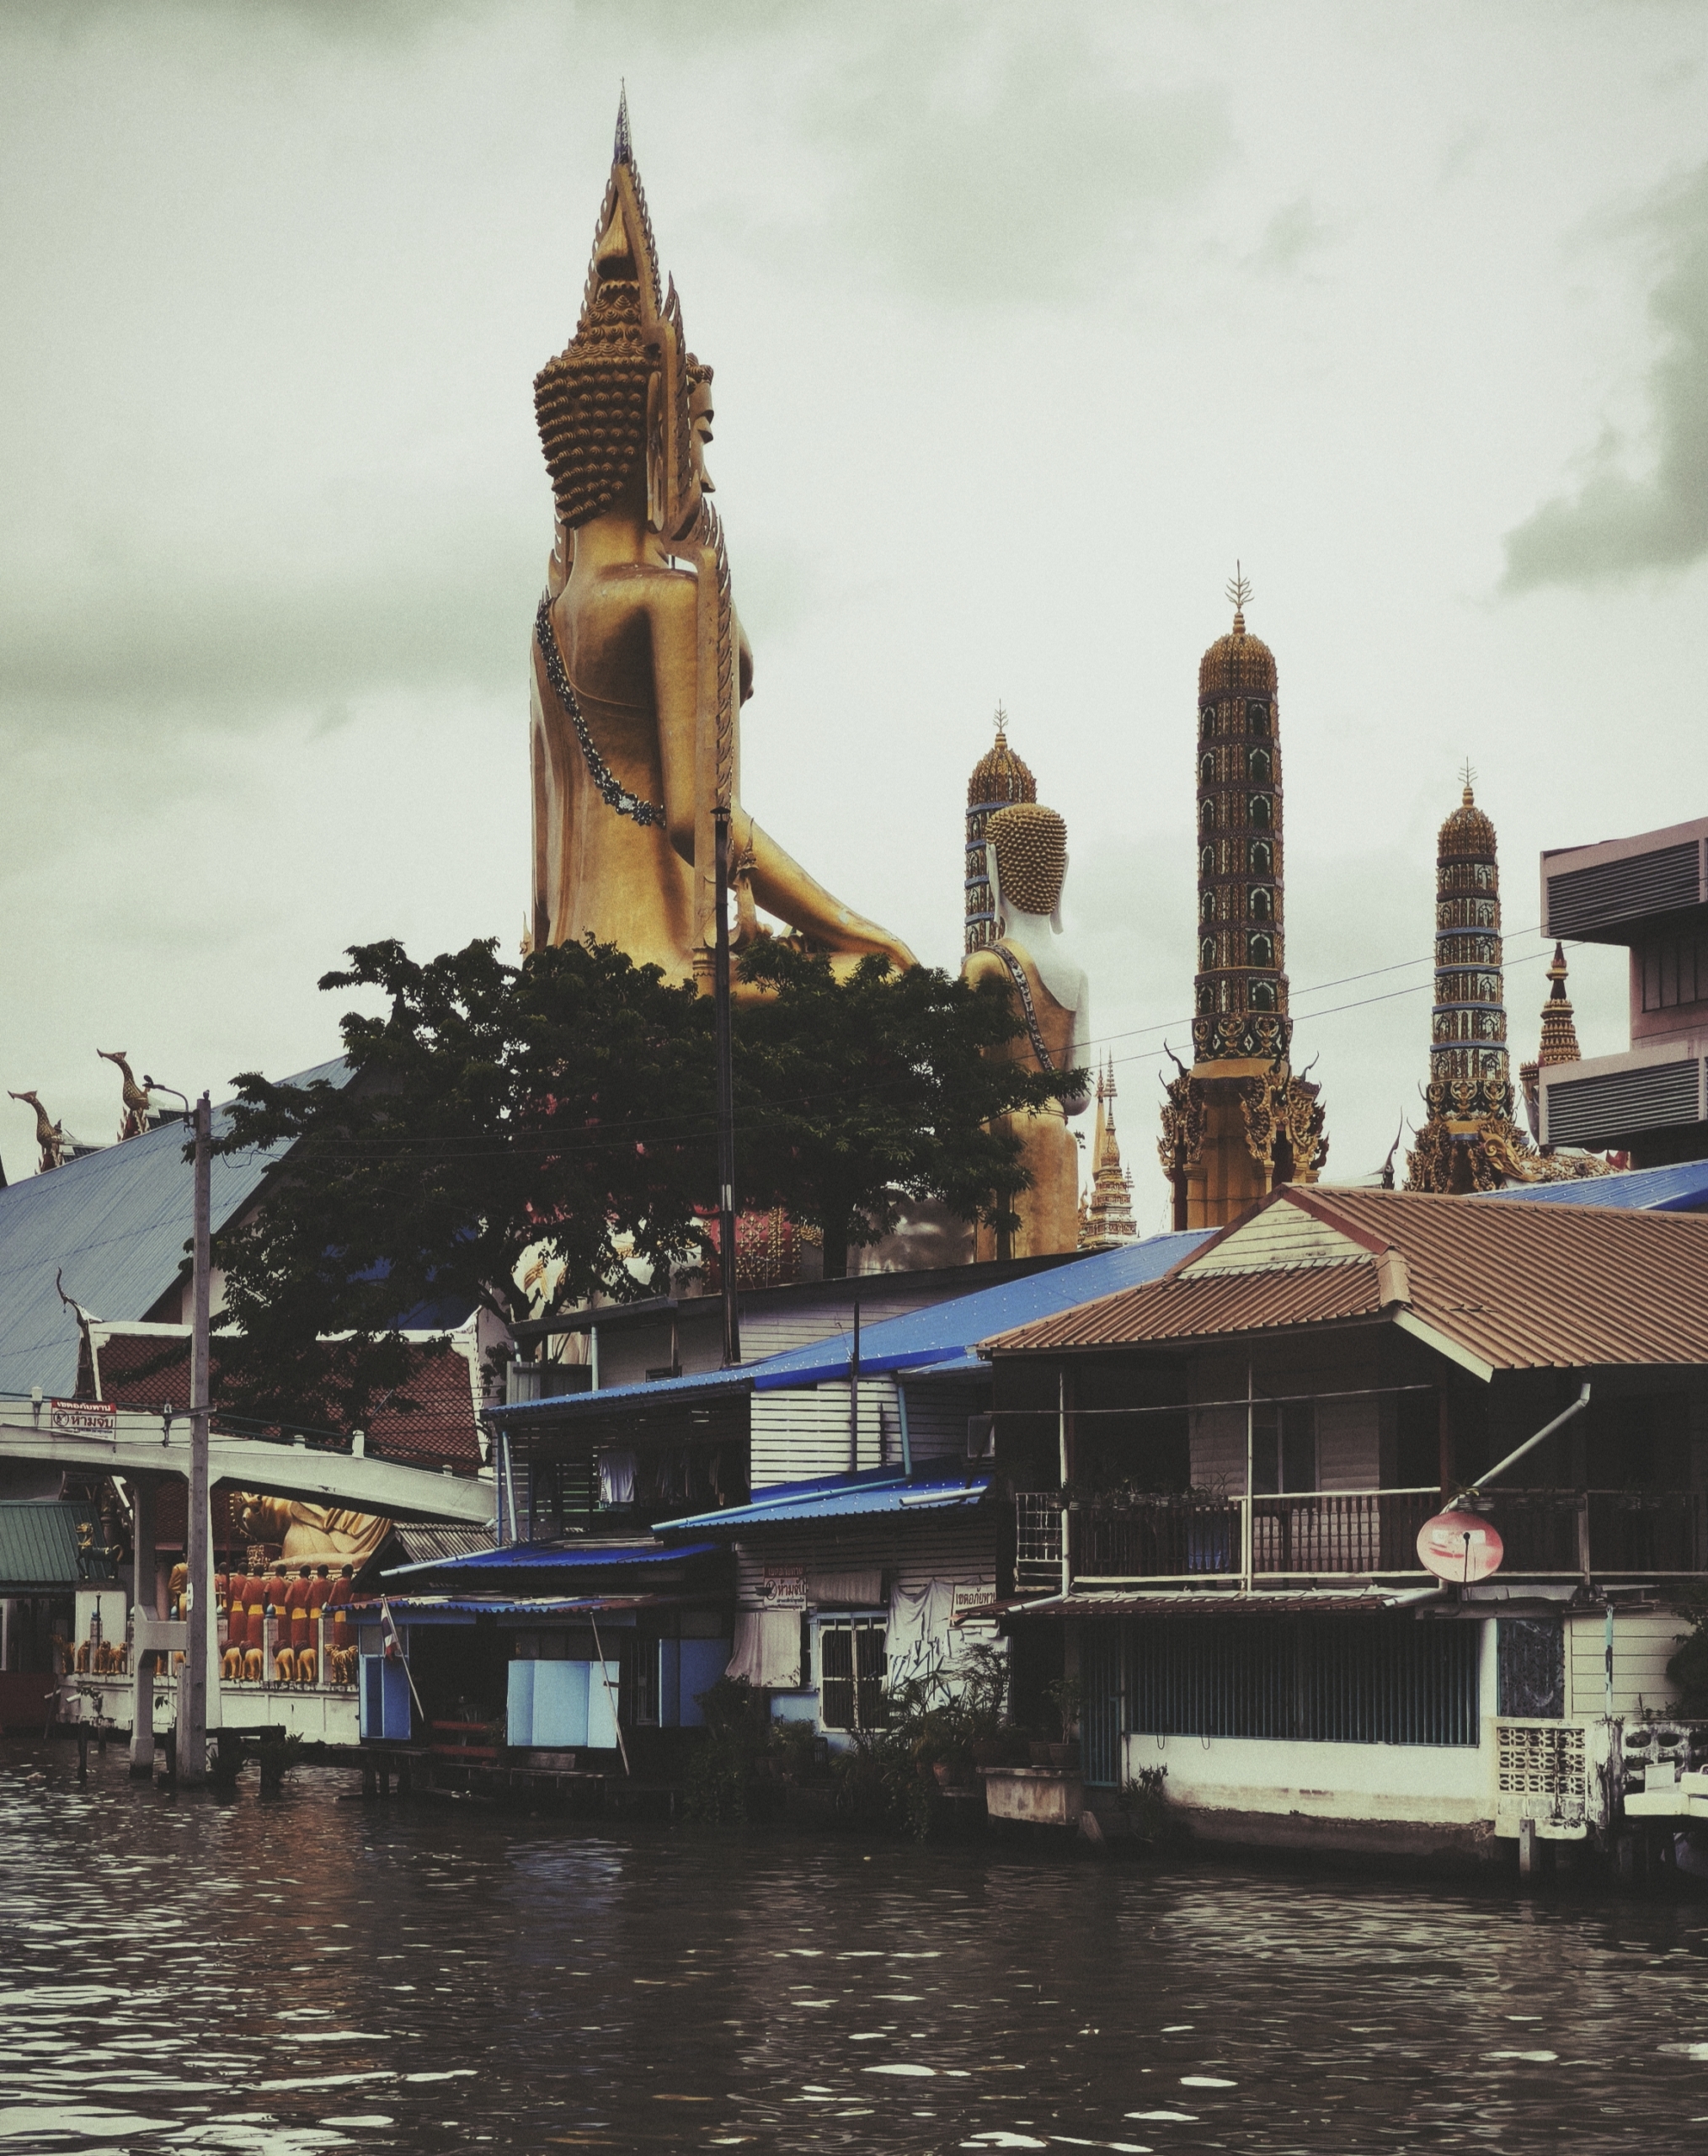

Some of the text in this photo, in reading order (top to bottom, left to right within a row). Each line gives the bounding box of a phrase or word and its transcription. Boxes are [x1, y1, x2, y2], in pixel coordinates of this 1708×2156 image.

[56, 1401, 110, 1412] เขตอภัยทาน
[71, 1411, 114, 1428] ห้ามจับ
